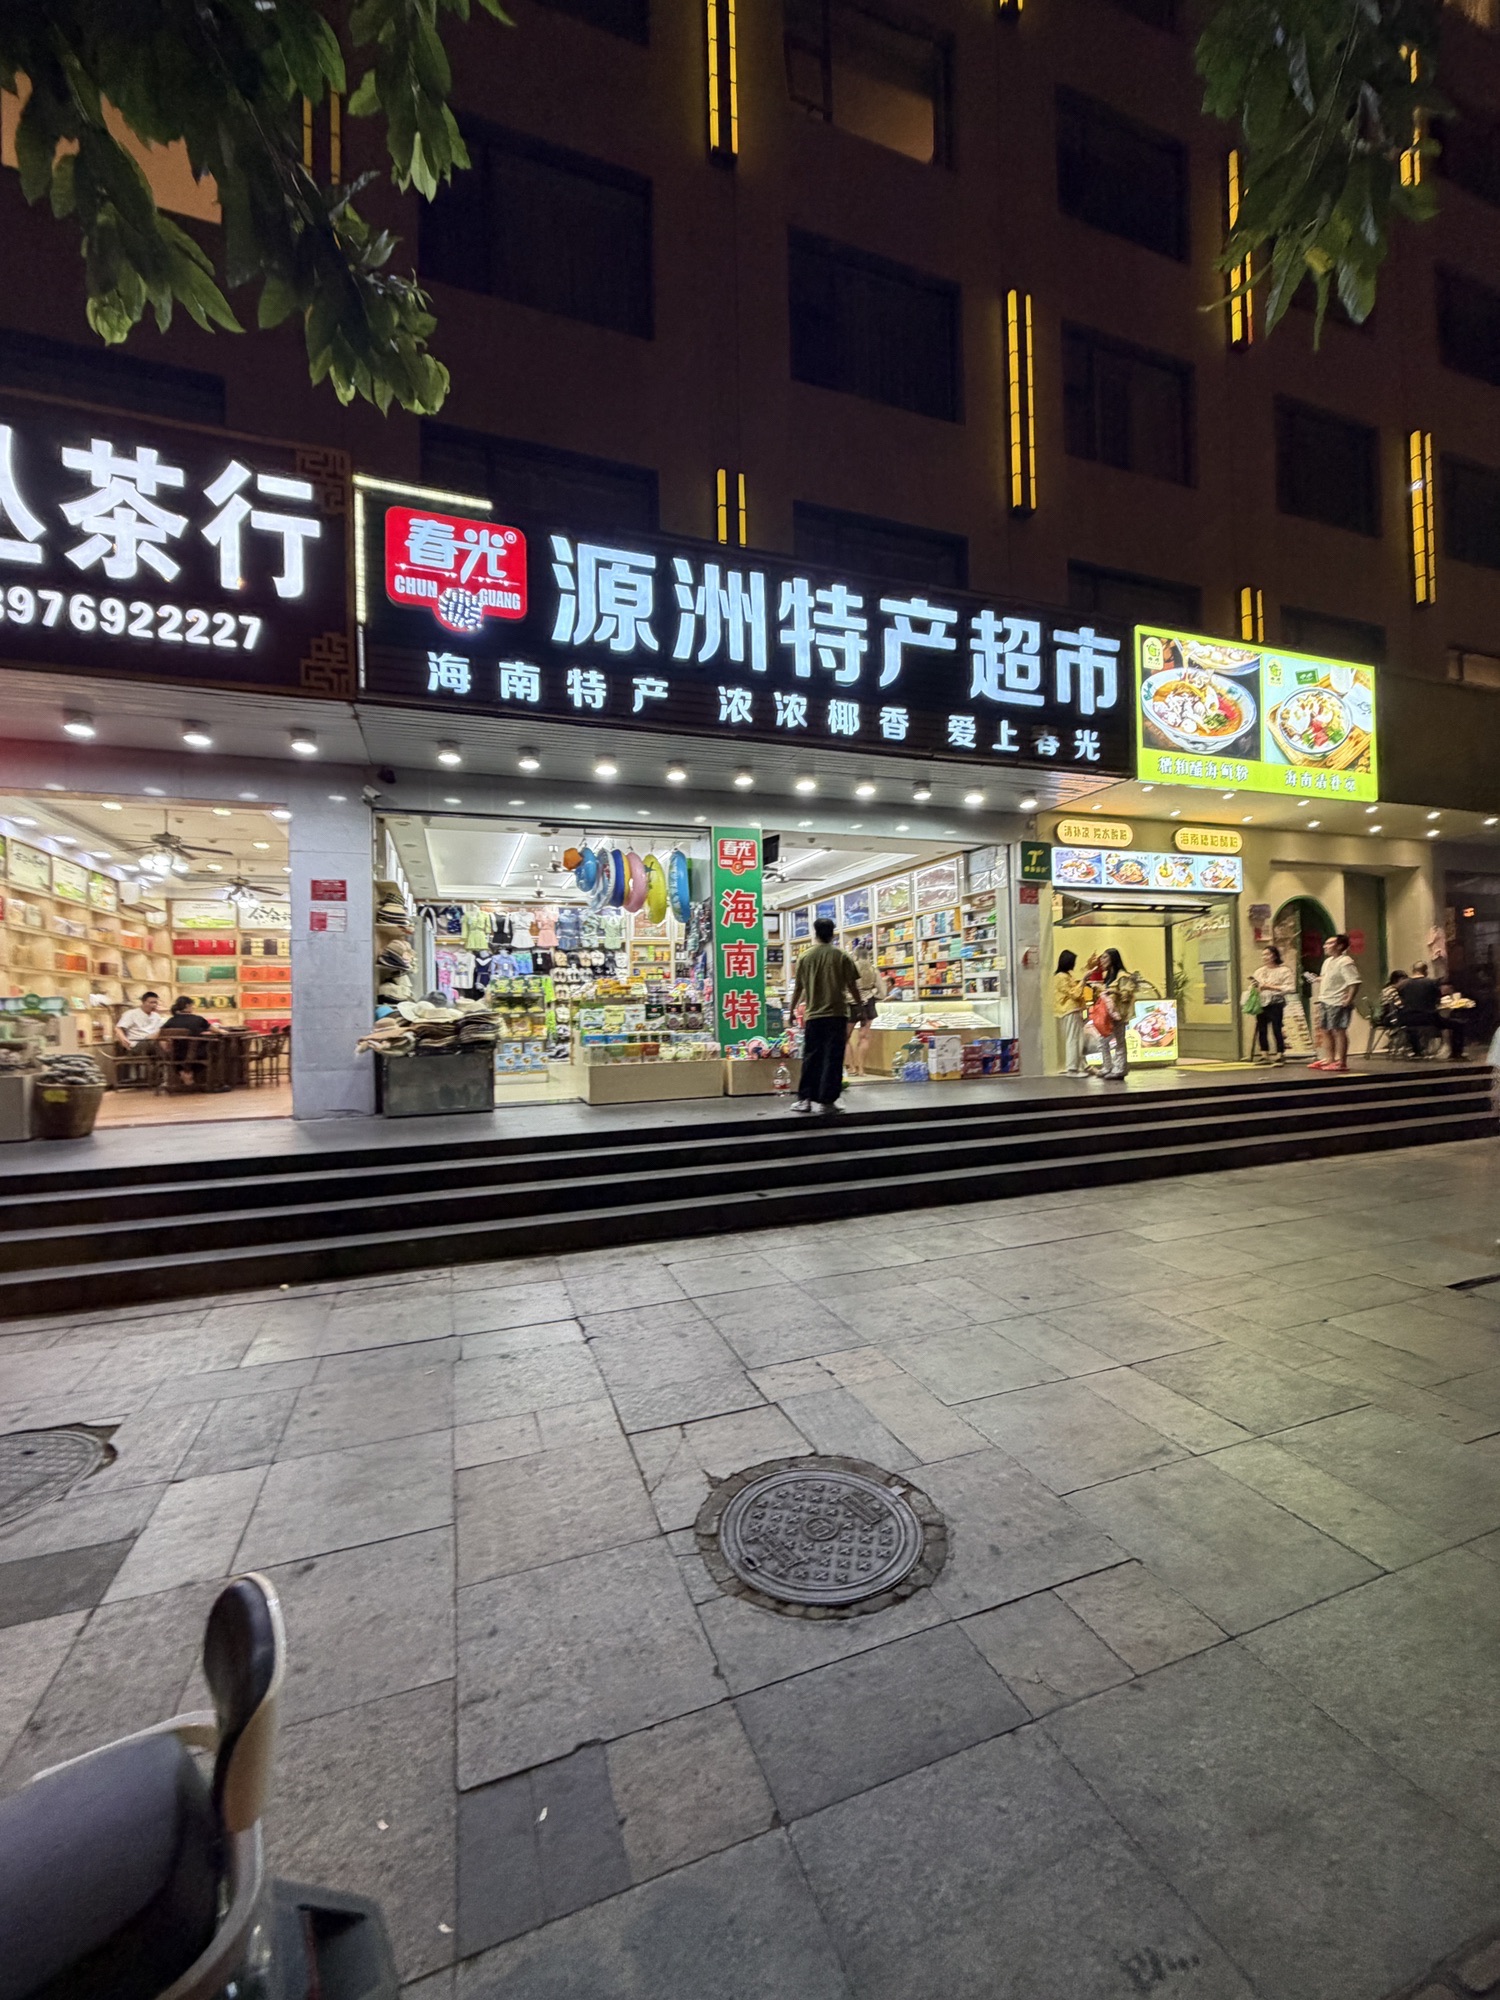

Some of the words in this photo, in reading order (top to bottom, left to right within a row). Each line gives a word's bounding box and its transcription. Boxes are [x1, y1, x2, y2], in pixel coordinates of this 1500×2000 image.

[404, 518, 508, 584] 春光
[0, 586, 262, 651] 976922227
[394, 575, 438, 598] CHUN
[479, 588, 521, 610] GUANG
[550, 535, 1121, 715] 源洲特产超市
[427, 651, 669, 713] 海南特产
[723, 841, 752, 860] 春光
[721, 889, 762, 1046] 海南特
